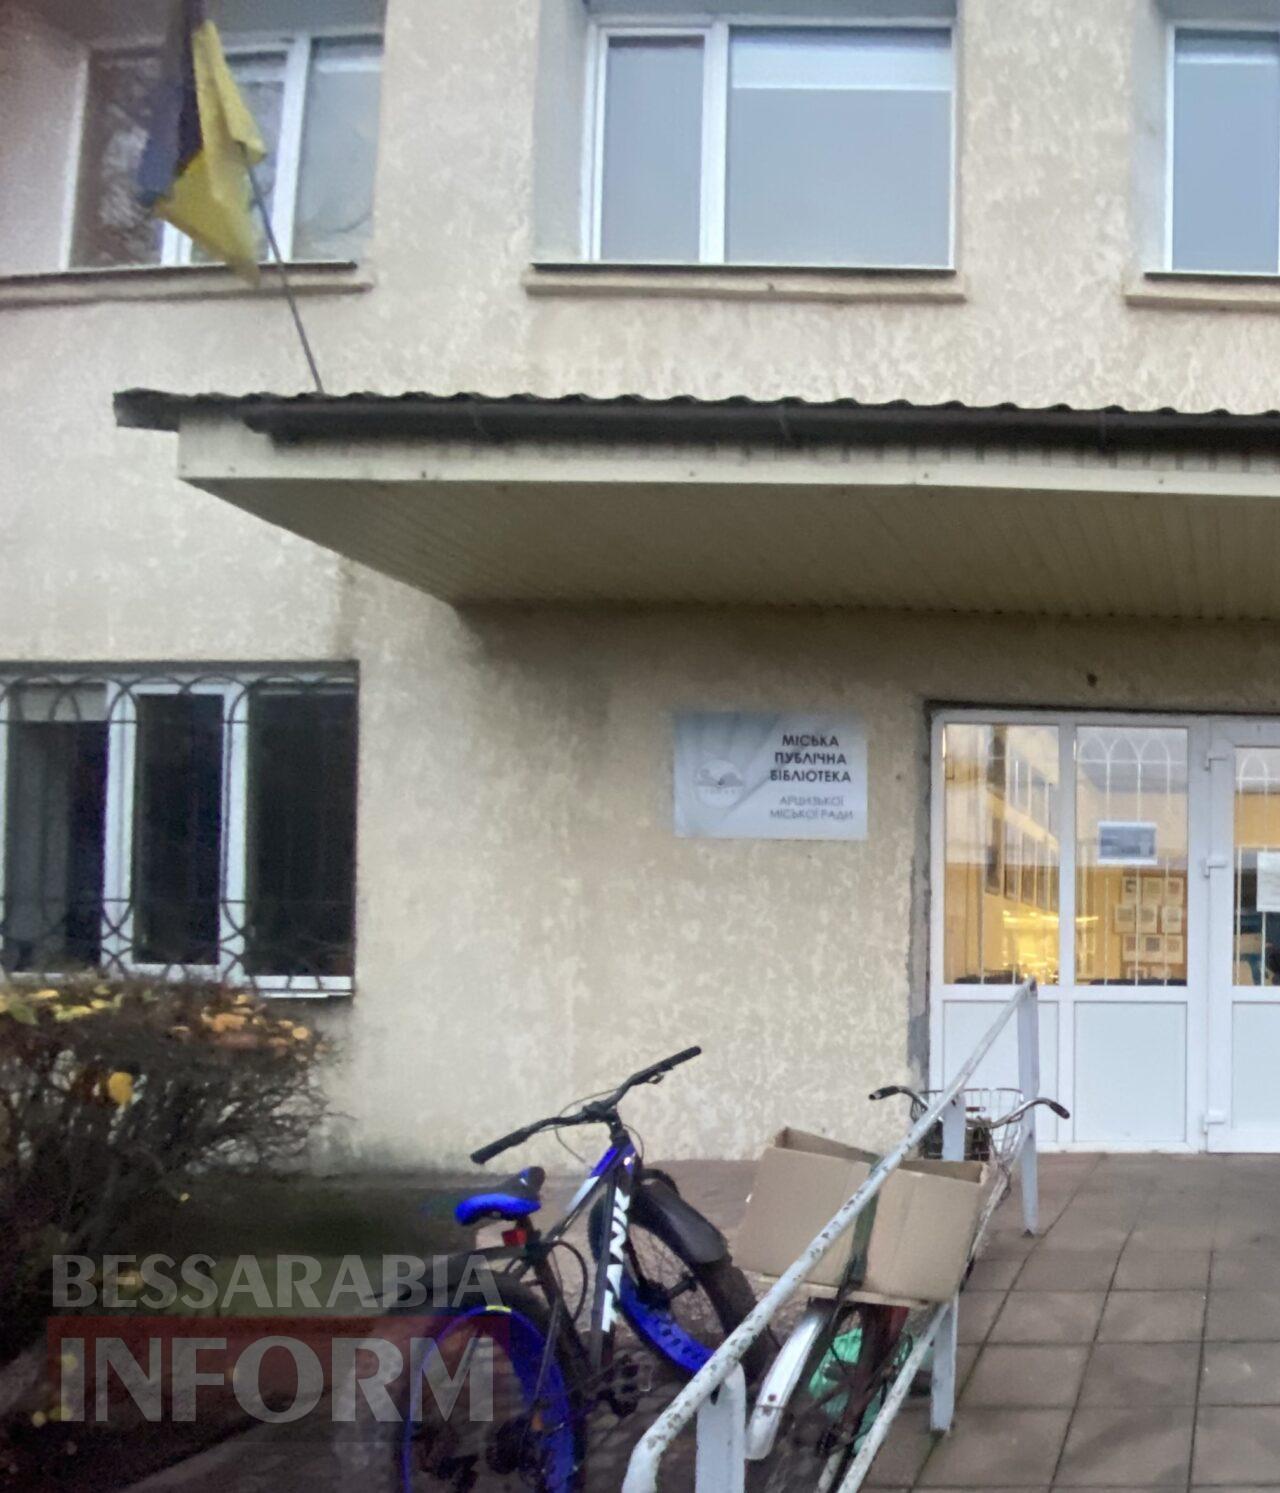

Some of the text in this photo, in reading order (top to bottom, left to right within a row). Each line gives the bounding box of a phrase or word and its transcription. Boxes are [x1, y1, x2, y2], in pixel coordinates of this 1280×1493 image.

[782, 734, 839, 747] МІСЬКА
[774, 752, 847, 765] ПУБЛІЧНА
[770, 770, 851, 782] БІБЛІОТЕКА
